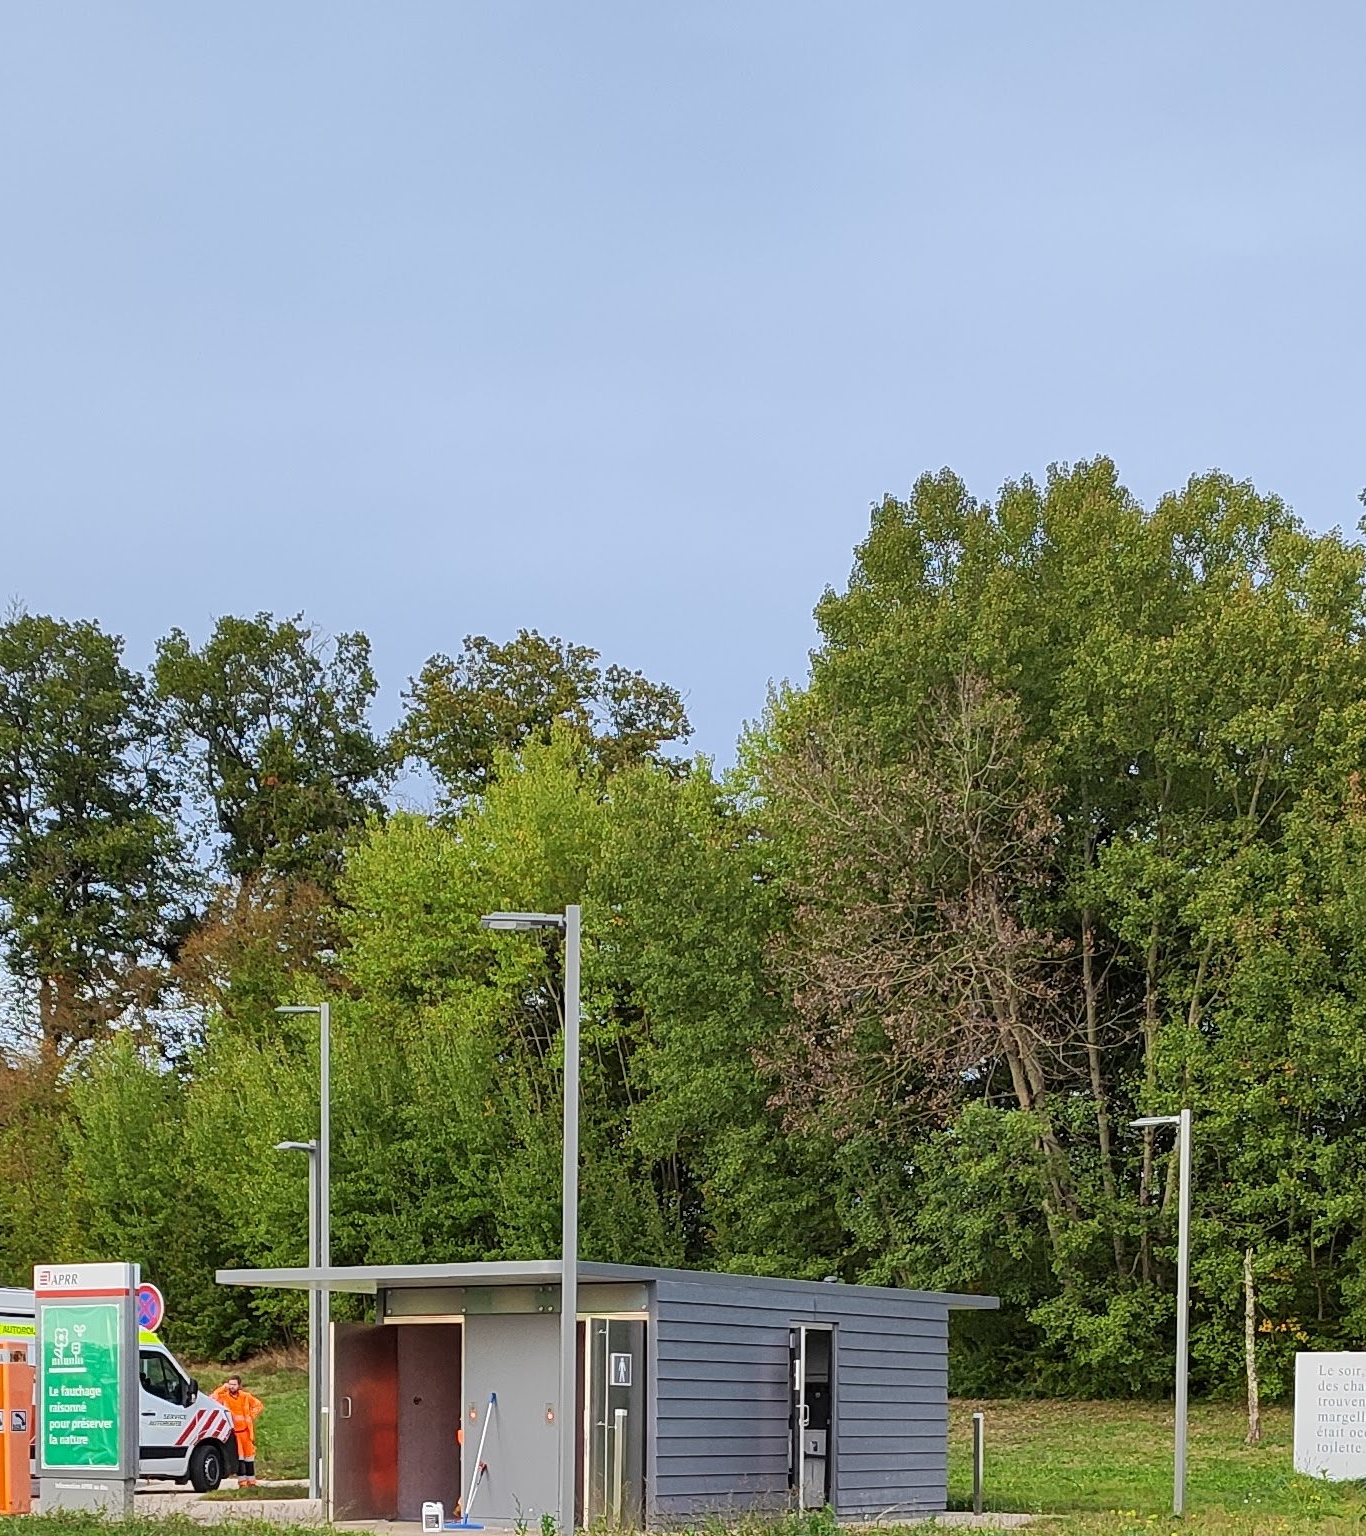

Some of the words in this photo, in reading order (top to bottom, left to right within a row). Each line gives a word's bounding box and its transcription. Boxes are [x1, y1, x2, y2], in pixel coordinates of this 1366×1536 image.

[51, 1274, 77, 1285] APRR
[1319, 1365, 1333, 1376] Le
[1339, 1367, 1365, 1377] soir,
[49, 1386, 59, 1396] Le
[61, 1385, 102, 1398] fauchage
[1318, 1380, 1338, 1392] des
[49, 1401, 87, 1412] raisonné
[49, 1420, 70, 1431] pour
[71, 1418, 113, 1431] préserver
[1317, 1426, 1344, 1437] était
[49, 1434, 58, 1444] la
[60, 1435, 88, 1444] nature
